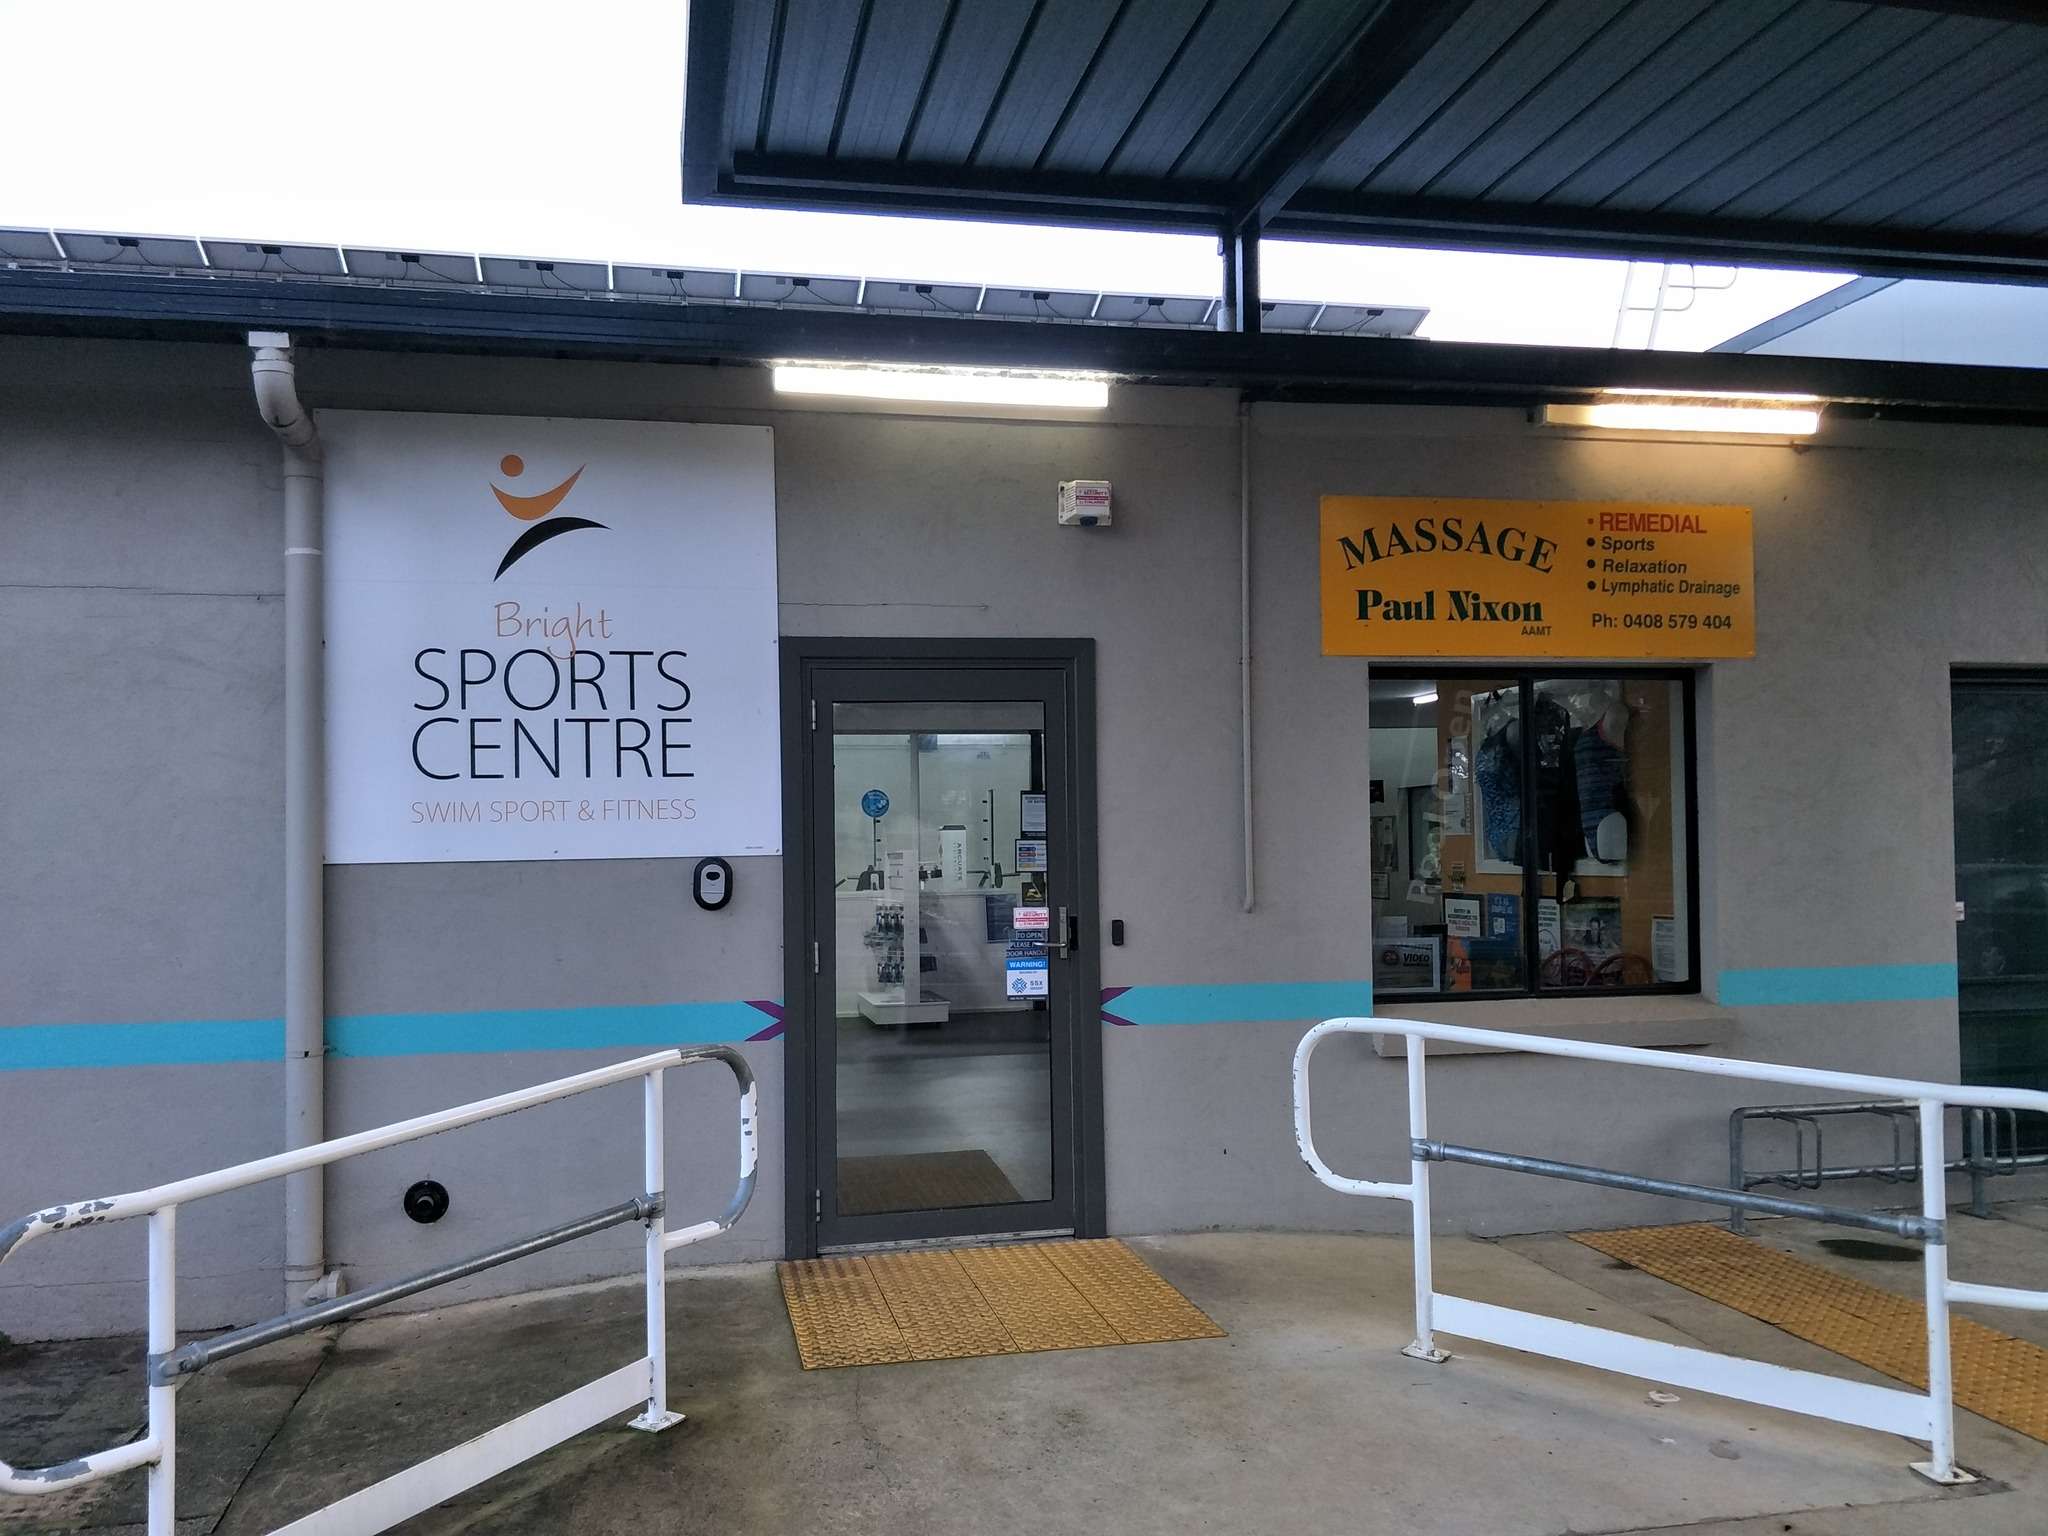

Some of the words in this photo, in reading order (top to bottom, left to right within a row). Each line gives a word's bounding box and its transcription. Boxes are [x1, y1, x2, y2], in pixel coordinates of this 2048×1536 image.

[1600, 512, 1707, 533] REMEDIAL
[1336, 517, 1558, 574] MASSAGE
[1601, 536, 1656, 554] Sports
[1603, 559, 1688, 574] Relaxation
[1602, 578, 1675, 595] Lymphatic
[1679, 580, 1740, 598] Drainage
[1354, 589, 1435, 621] Paul
[1447, 590, 1543, 622] Nixon
[494, 601, 613, 660] Bright
[1521, 625, 1552, 636] AAMT
[1592, 613, 1618, 628] Ph:
[1623, 614, 1663, 629] 0408
[1668, 615, 1698, 629] 579
[1702, 615, 1732, 629] 404
[414, 648, 691, 712] SPORTS
[411, 717, 694, 780] CENTRE
[411, 801, 481, 824] SWIM
[490, 800, 571, 823] SPORT
[577, 800, 595, 821] &
[603, 798, 697, 821] FITNESS
[1009, 961, 1046, 969] WARNING!
[1403, 952, 1430, 962] VIDEO
